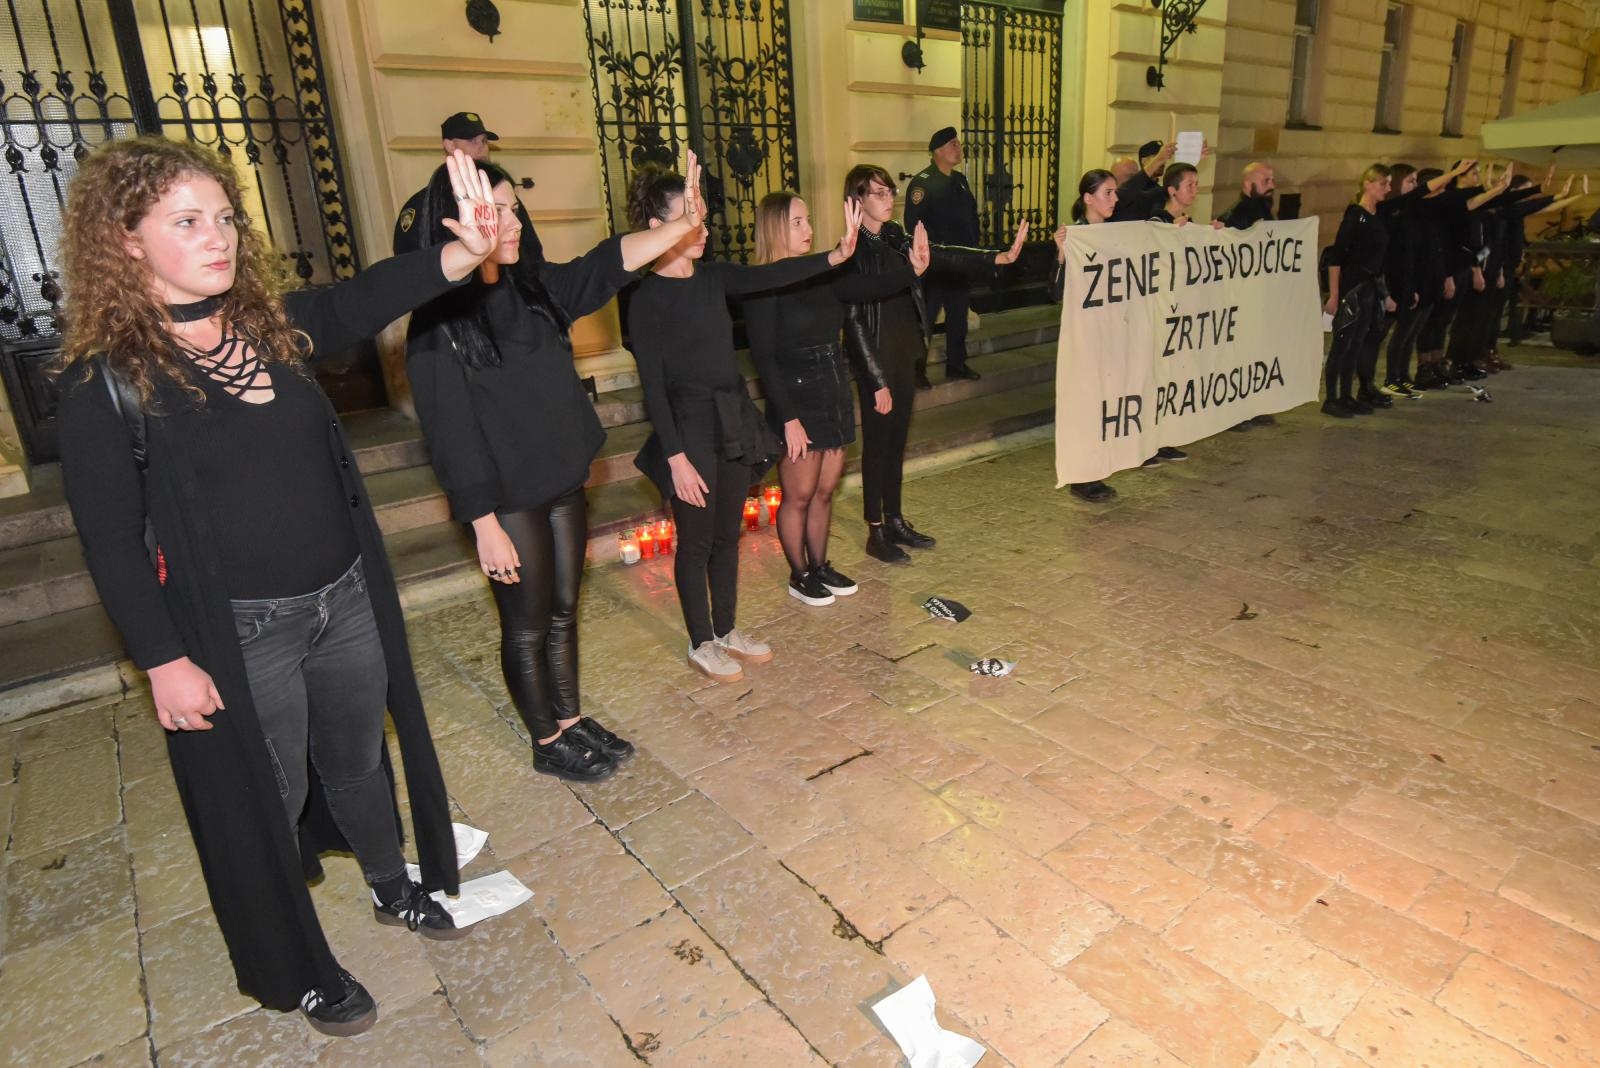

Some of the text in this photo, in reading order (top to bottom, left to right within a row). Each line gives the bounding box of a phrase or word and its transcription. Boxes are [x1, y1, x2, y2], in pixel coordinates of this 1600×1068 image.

[1082, 229, 1303, 309] ŽENE I DJEVOJČICE
[1162, 303, 1239, 357] ŽRTVE
[1101, 356, 1285, 442] HR PRAVOSUĐA
